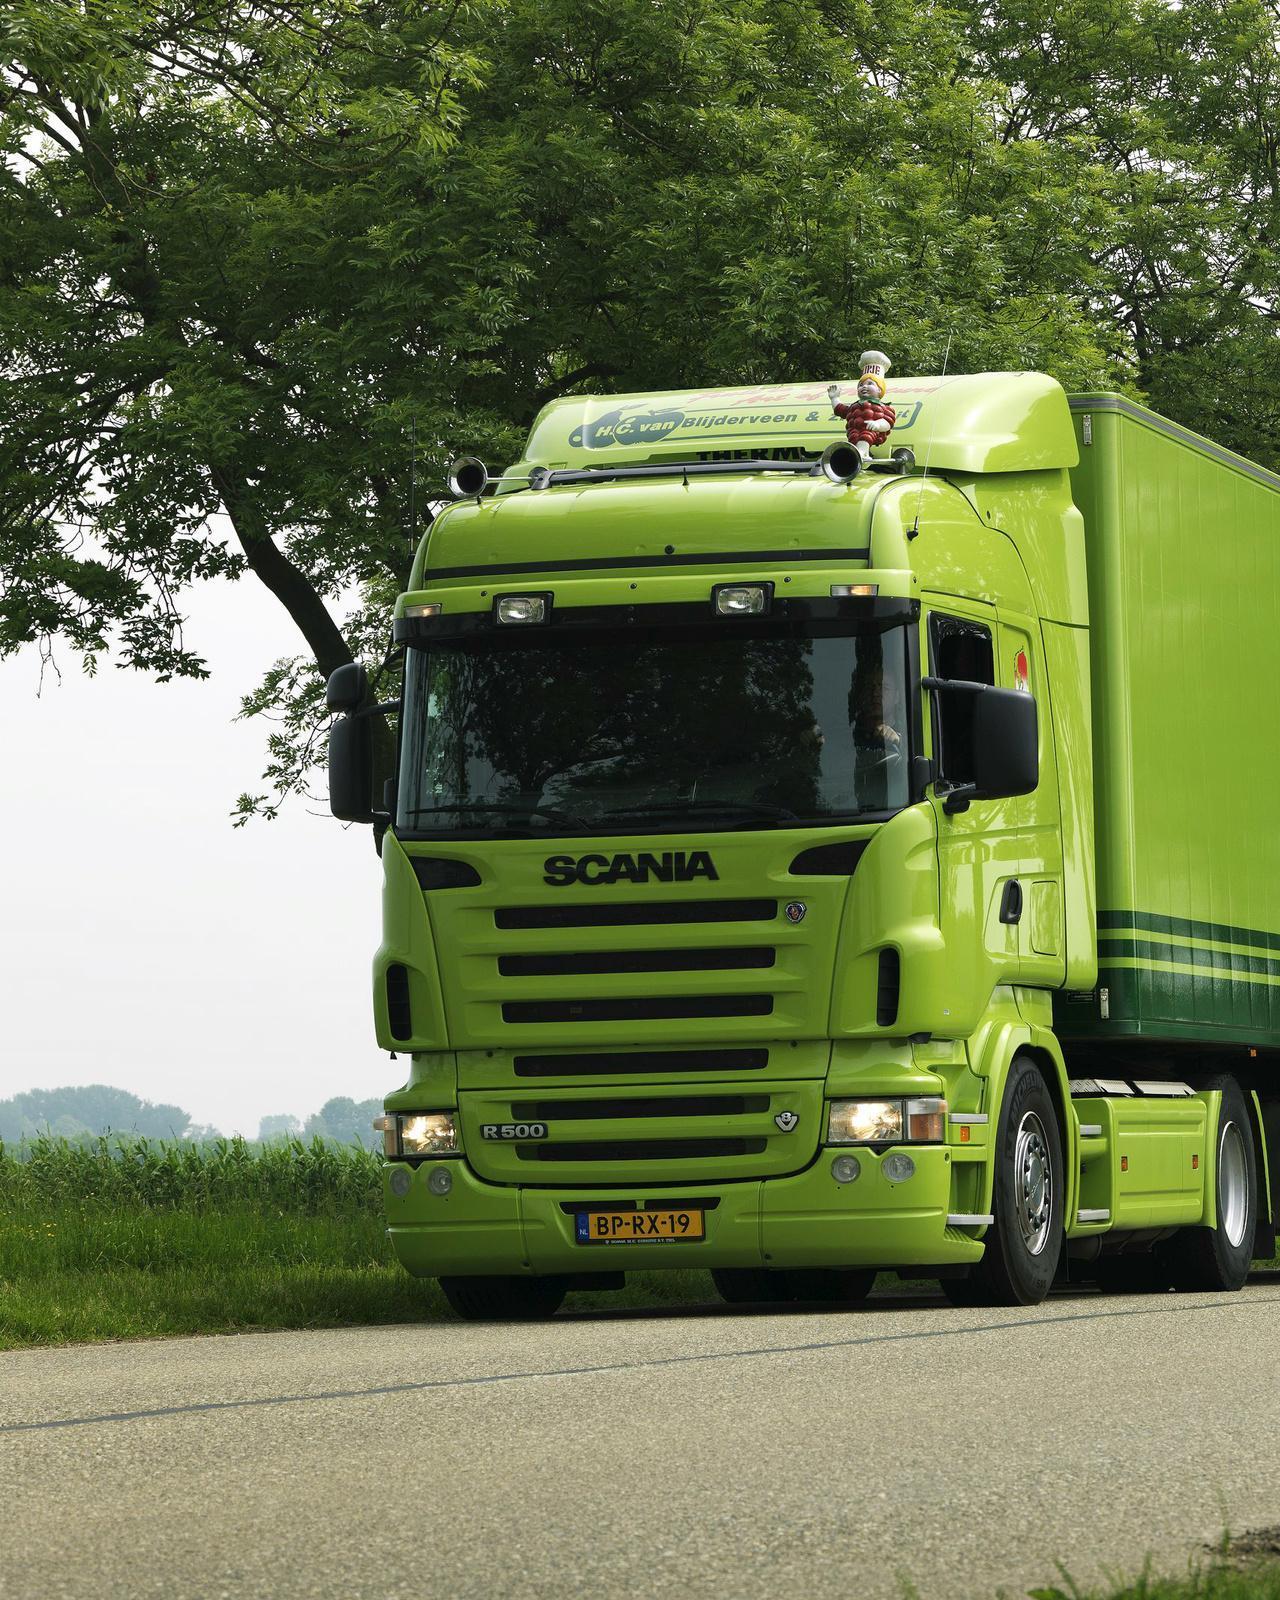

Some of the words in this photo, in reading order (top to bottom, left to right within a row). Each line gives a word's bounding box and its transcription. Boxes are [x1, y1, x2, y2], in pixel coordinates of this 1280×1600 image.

[640, 420, 674, 433] van
[681, 413, 797, 428] Blijderveen
[805, 411, 819, 421] &
[543, 851, 720, 886] SCANIA
[483, 1125, 499, 1139] R
[501, 1124, 544, 1138] 500
[596, 1213, 690, 1236] BP-RX-19
